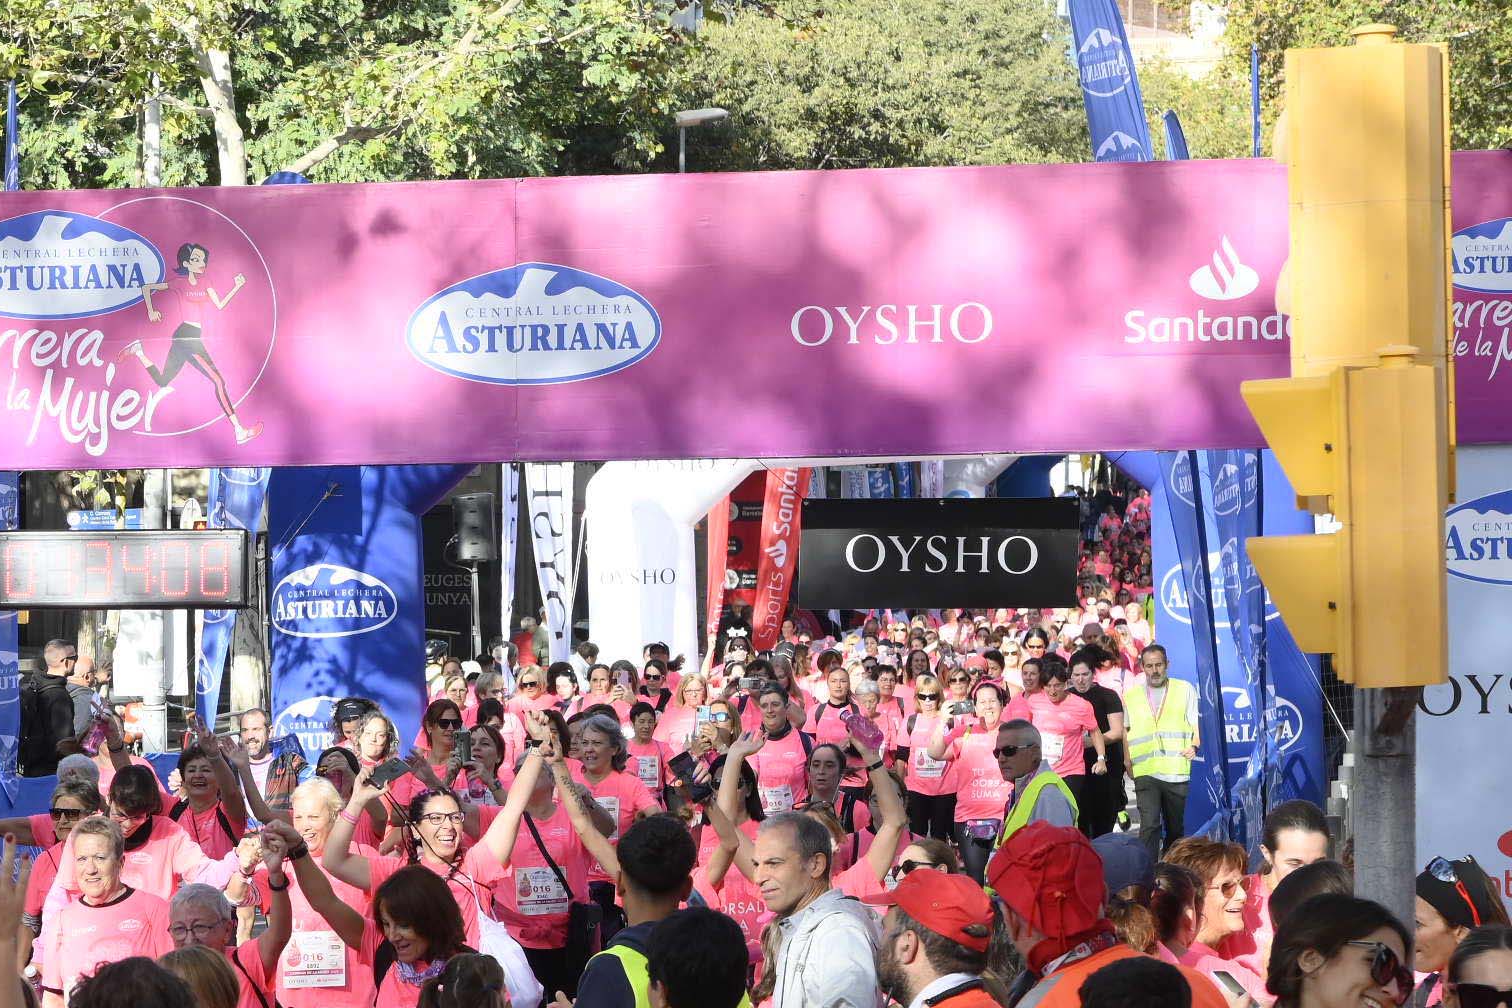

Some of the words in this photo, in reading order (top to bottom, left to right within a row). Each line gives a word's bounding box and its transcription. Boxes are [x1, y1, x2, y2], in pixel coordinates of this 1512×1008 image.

[68, 246, 141, 259] LECHERA
[464, 304, 546, 319] CENTRAL
[551, 302, 633, 317] LECHERA
[427, 310, 641, 355] ASTURIANA
[790, 301, 994, 347] OYSHO
[1474, 330, 1493, 356] la
[6, 371, 31, 411] la
[26, 362, 176, 457] Mujer
[845, 533, 1039, 575] OYSHO
[600, 567, 677, 586] OYSHO
[288, 588, 330, 599] CENTRAL
[335, 588, 384, 598] LECHERA
[275, 593, 388, 622] ASTURIANA
[971, 767, 985, 776] TU
[971, 790, 1001, 799] SUMA
[533, 885, 551, 893] 016
[303, 953, 324, 961] 016
